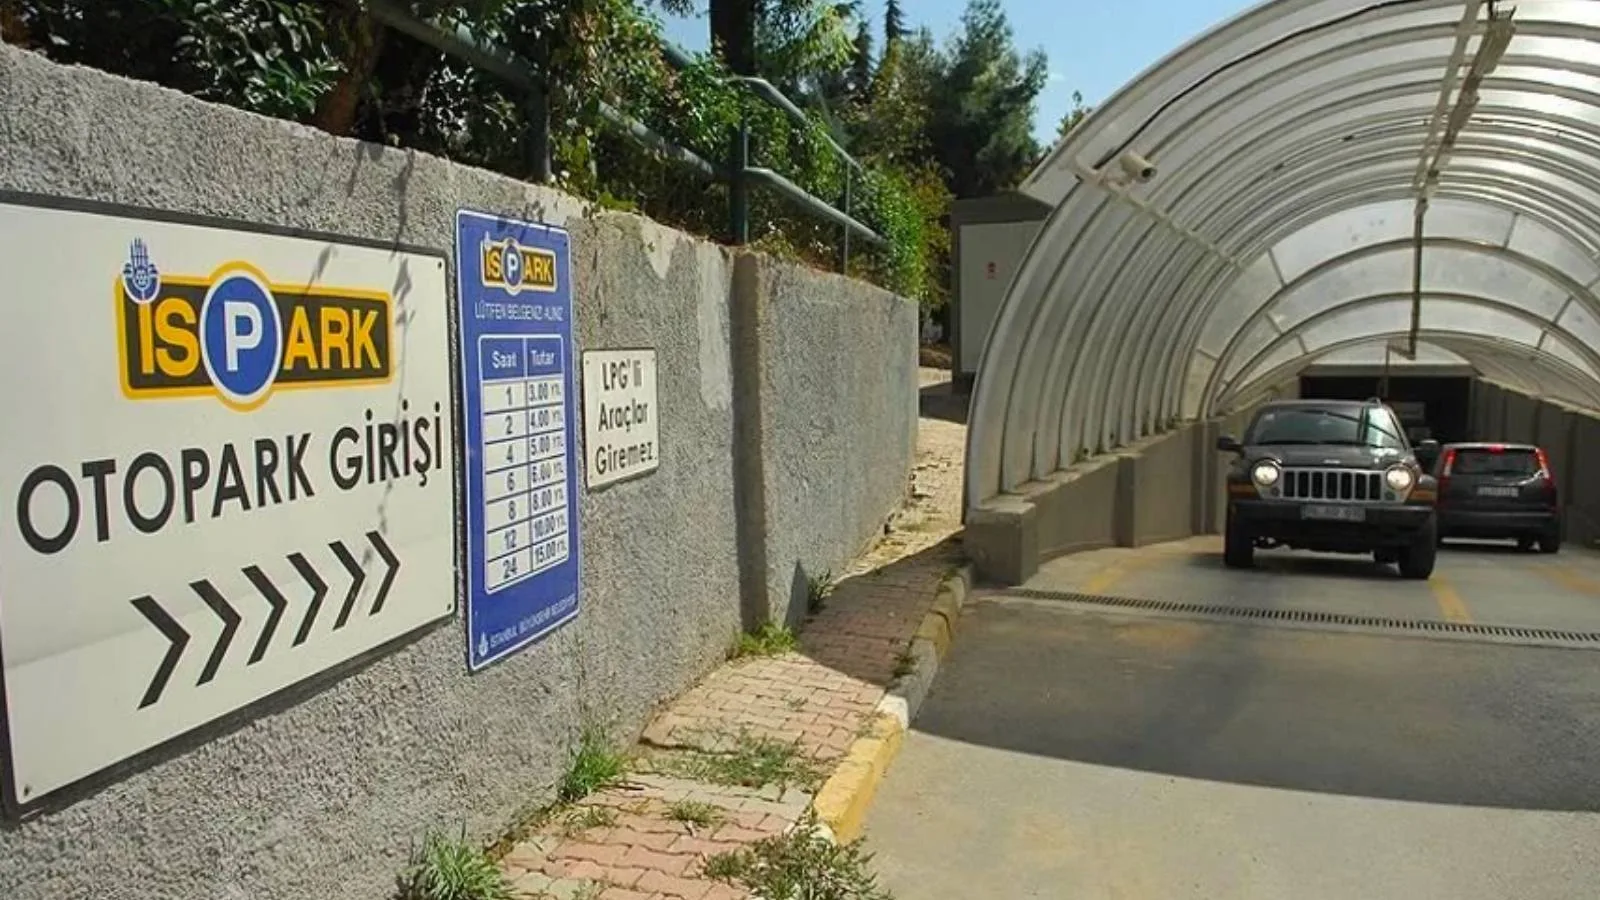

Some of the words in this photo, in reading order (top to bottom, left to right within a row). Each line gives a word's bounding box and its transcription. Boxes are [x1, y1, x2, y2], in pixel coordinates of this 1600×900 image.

[492, 350, 517, 369] Saat
[530, 349, 555, 366] Tutar
[601, 358, 643, 391] LPG'li
[506, 386, 512, 406] 1
[528, 383, 548, 402] 3.00
[505, 415, 513, 435] 2
[598, 398, 648, 432] Araçlar
[506, 445, 514, 463] 4
[531, 436, 550, 456] 5.00
[595, 441, 653, 475] Giremez
[16, 432, 315, 555] OTOPARK
[329, 400, 442, 491] GİRİŞİ
[507, 471, 515, 491] 6
[508, 500, 516, 520] 8
[504, 529, 516, 550] 12
[502, 556, 516, 580] 24
[534, 541, 556, 565] 15.00
